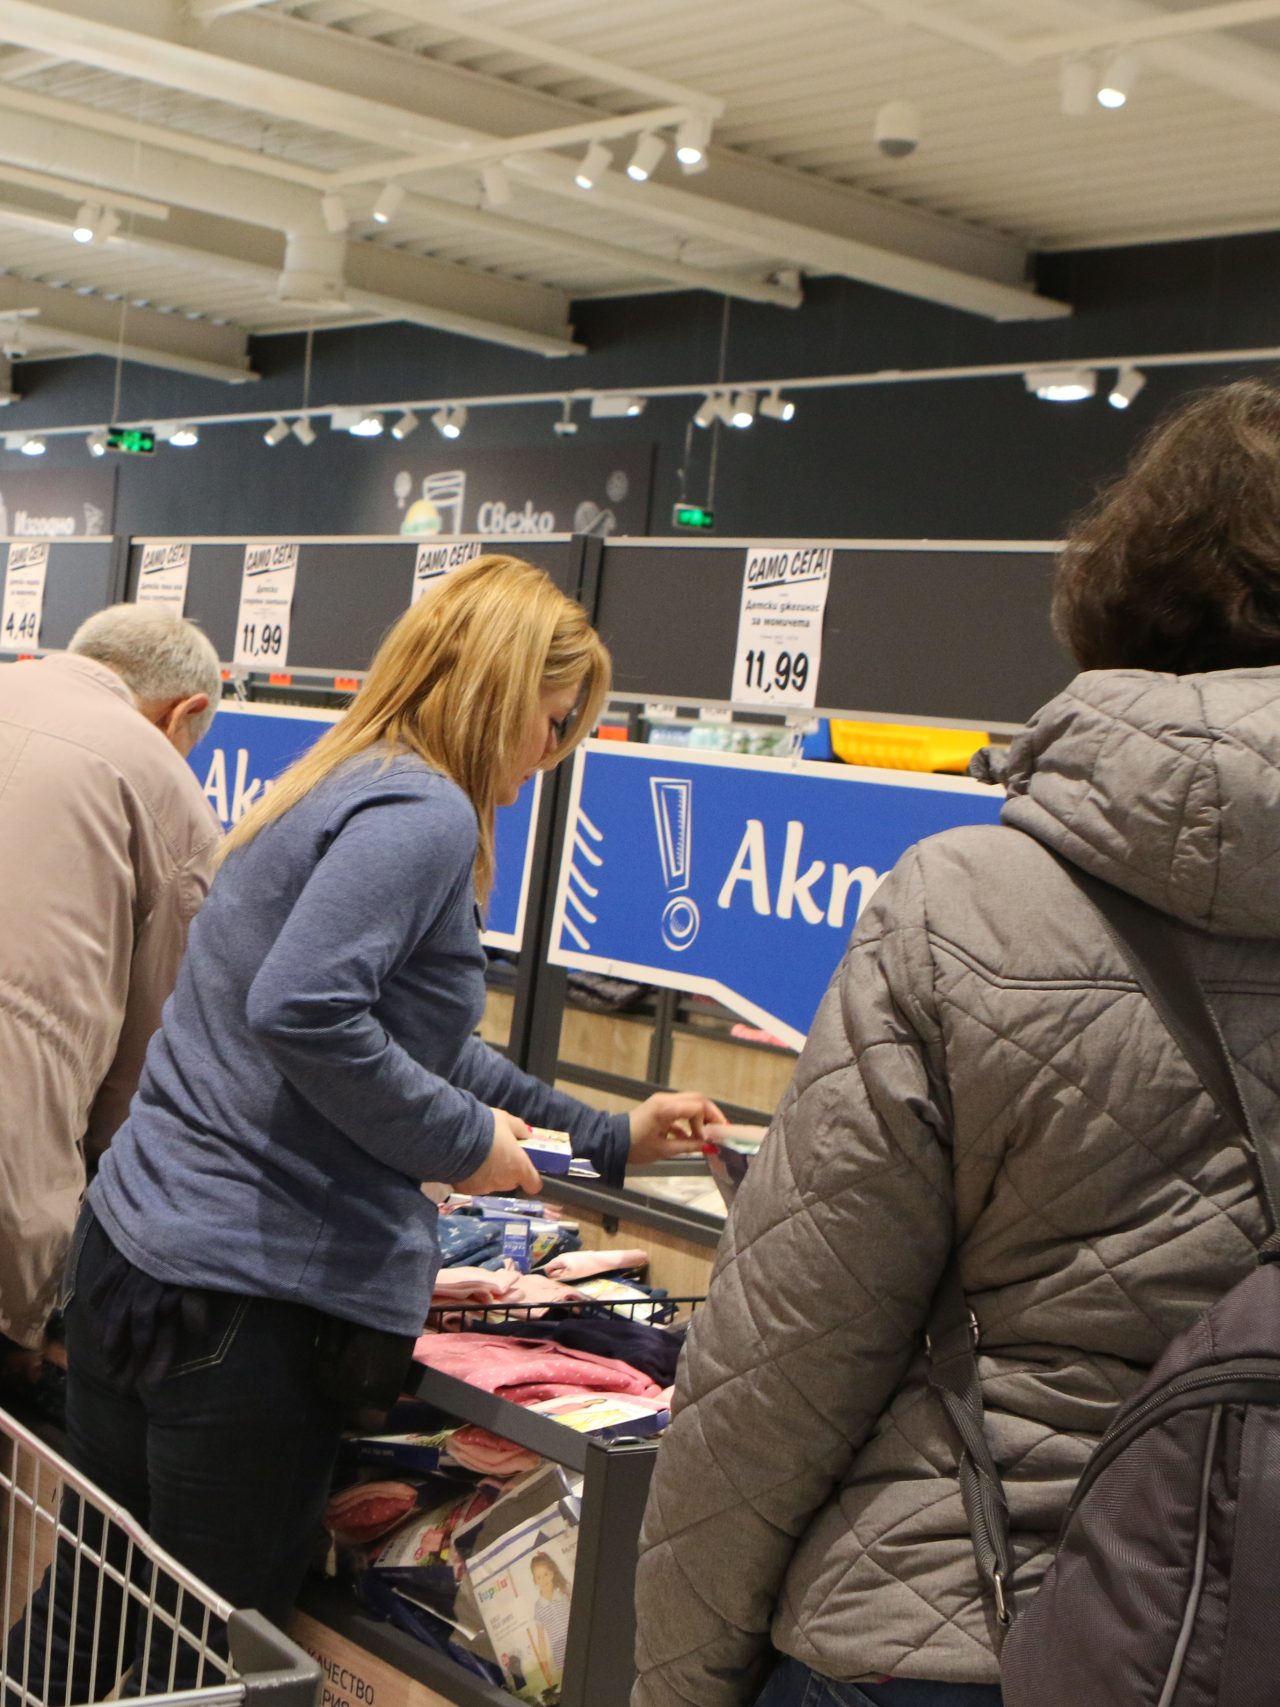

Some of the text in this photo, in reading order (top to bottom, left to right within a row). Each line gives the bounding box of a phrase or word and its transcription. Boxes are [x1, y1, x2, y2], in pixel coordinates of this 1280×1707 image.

[418, 547, 448, 573] САМО
[747, 551, 789, 582] САМО
[5, 612, 37, 640] 4,49
[242, 623, 283, 657] 11,99
[745, 649, 810, 693] 11,99
[203, 748, 274, 822] Ак
